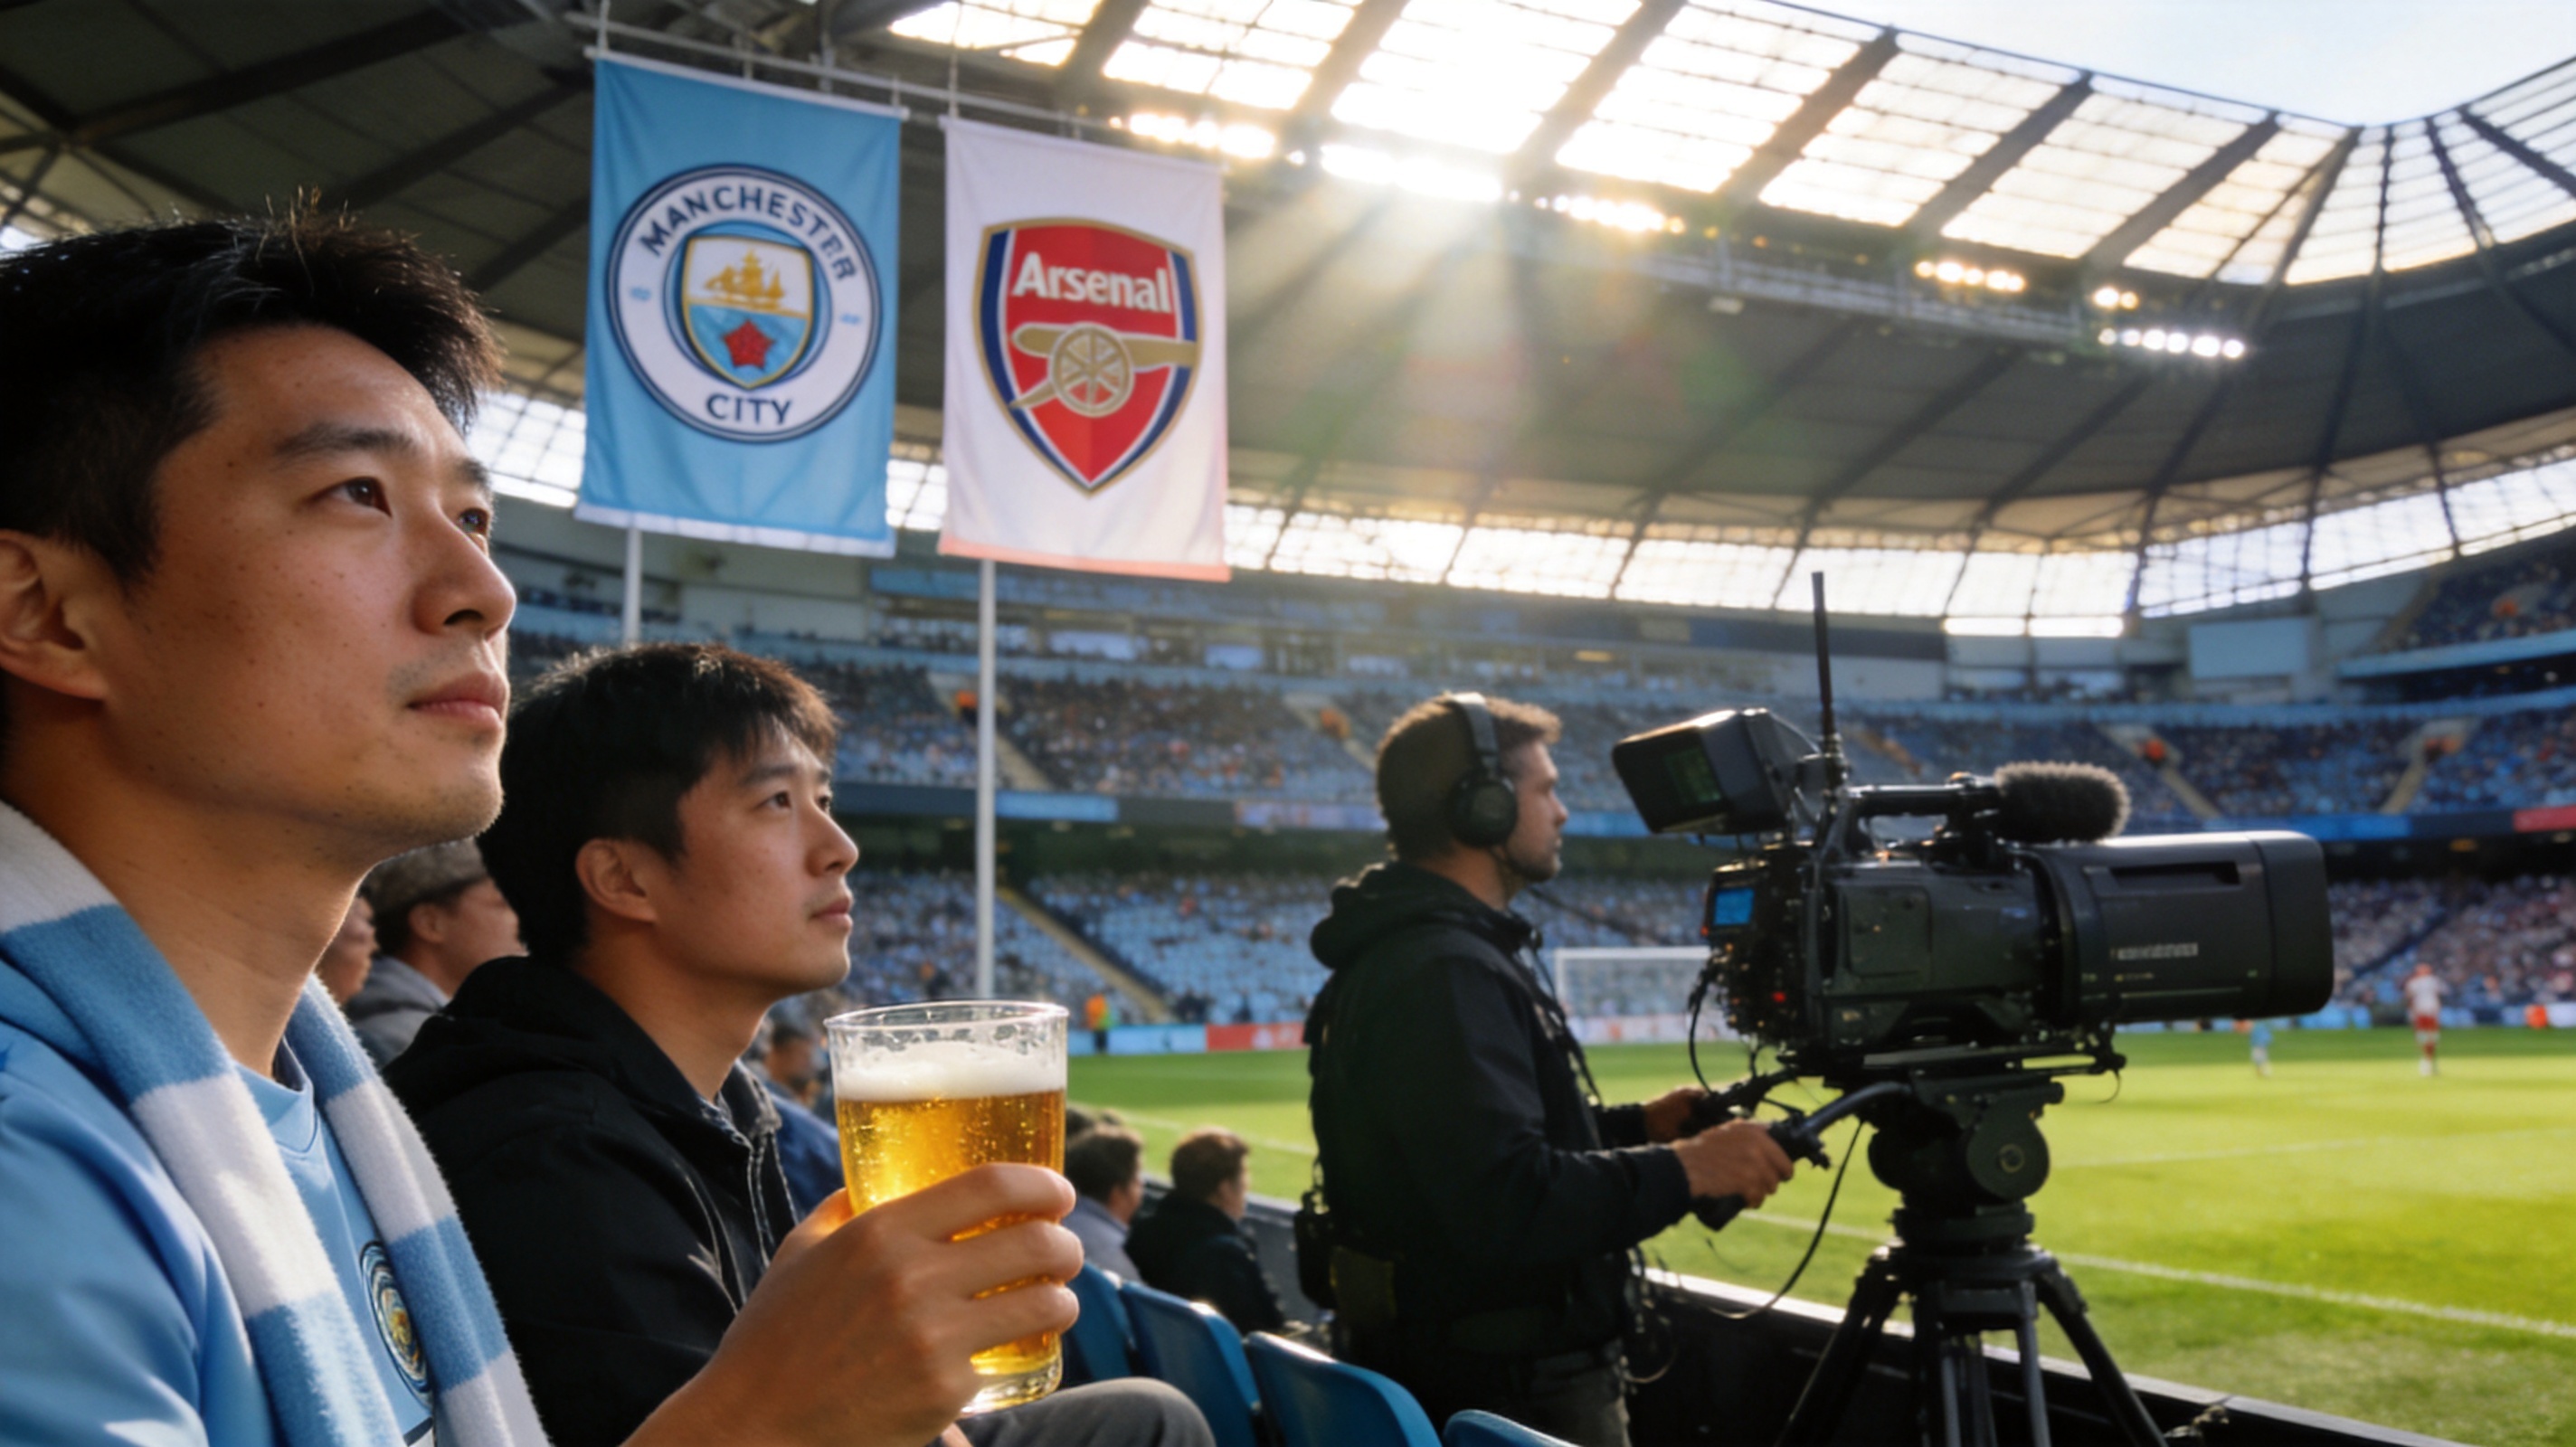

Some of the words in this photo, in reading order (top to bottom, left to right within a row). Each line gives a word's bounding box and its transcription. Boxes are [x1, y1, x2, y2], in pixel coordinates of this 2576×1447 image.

[639, 185, 857, 280] MANCHESTER
[1012, 251, 1171, 313] Arsenal
[706, 392, 791, 424] CITY
